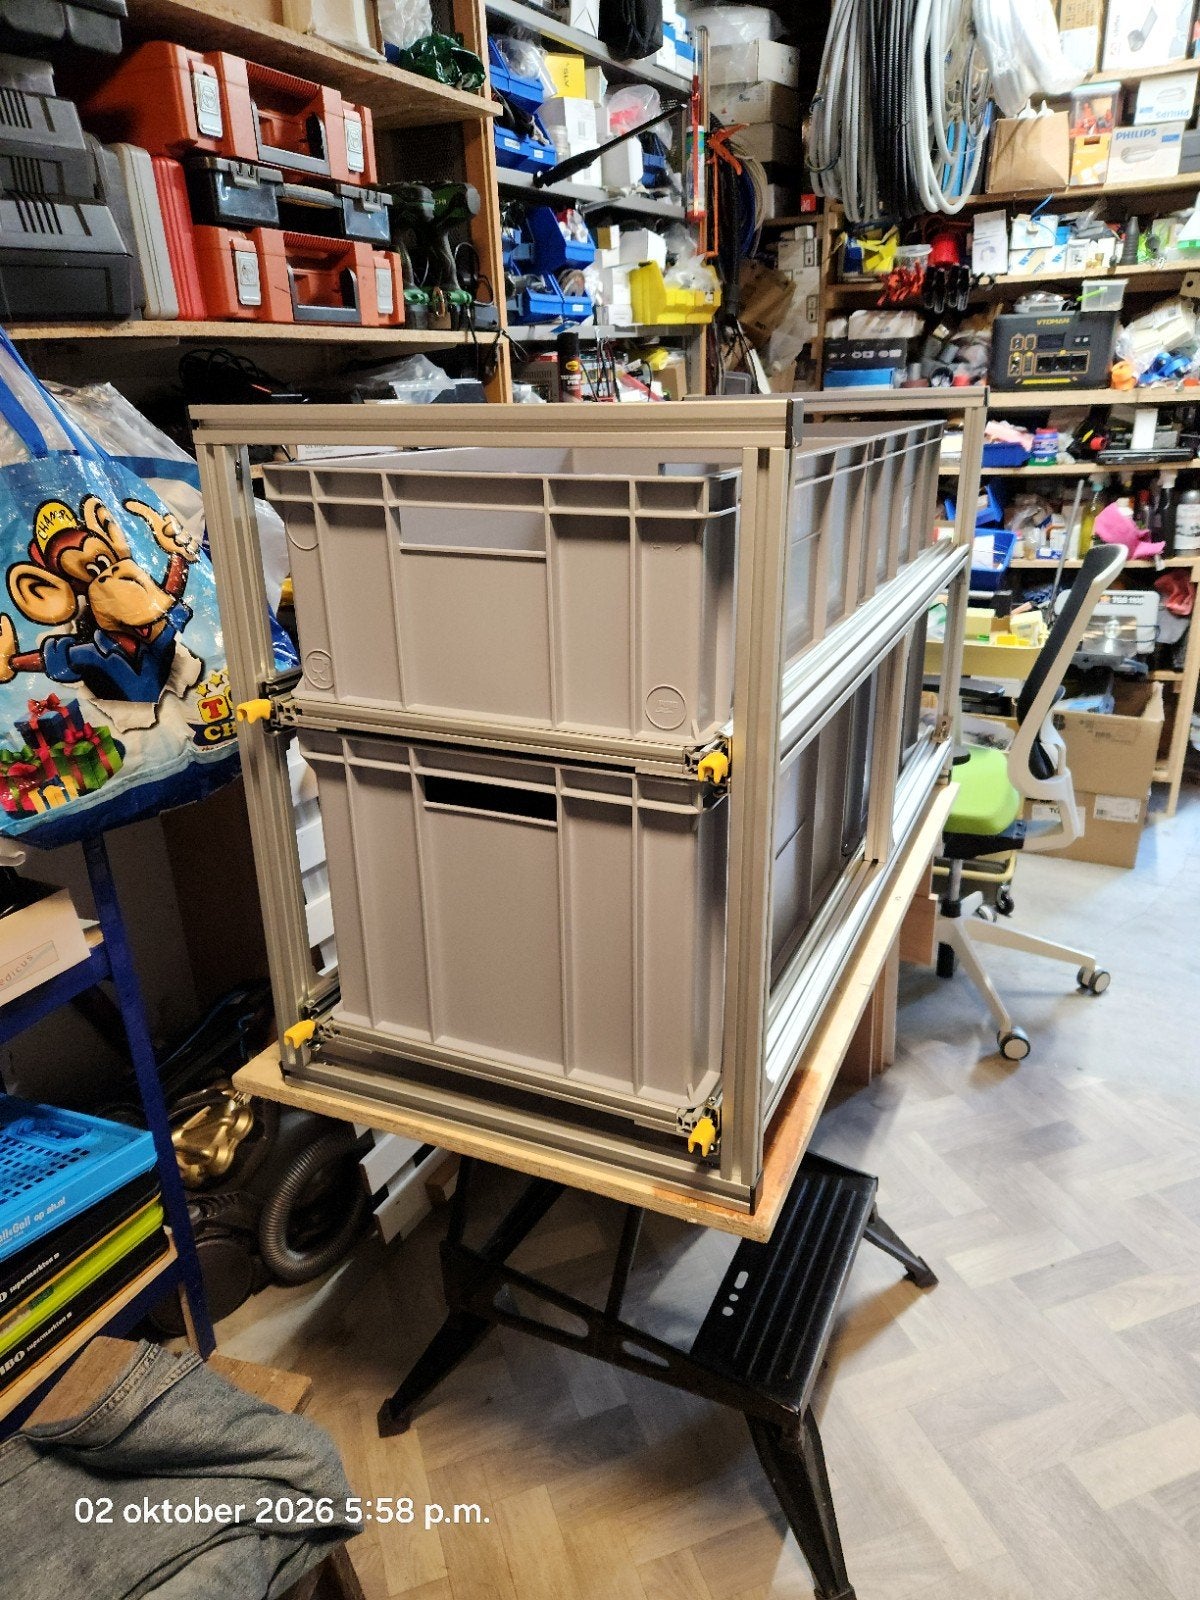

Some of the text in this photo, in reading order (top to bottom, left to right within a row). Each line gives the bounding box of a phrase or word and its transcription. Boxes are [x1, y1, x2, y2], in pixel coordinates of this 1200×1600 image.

[1156, 109, 1190, 120] PHILIPS
[1115, 128, 1158, 141] PHILIPS
[33, 1211, 45, 1222] op
[46, 1196, 66, 1215] ah.nl
[9, 1258, 54, 1293] supermarkten
[26, 1316, 67, 1352] supermarkten
